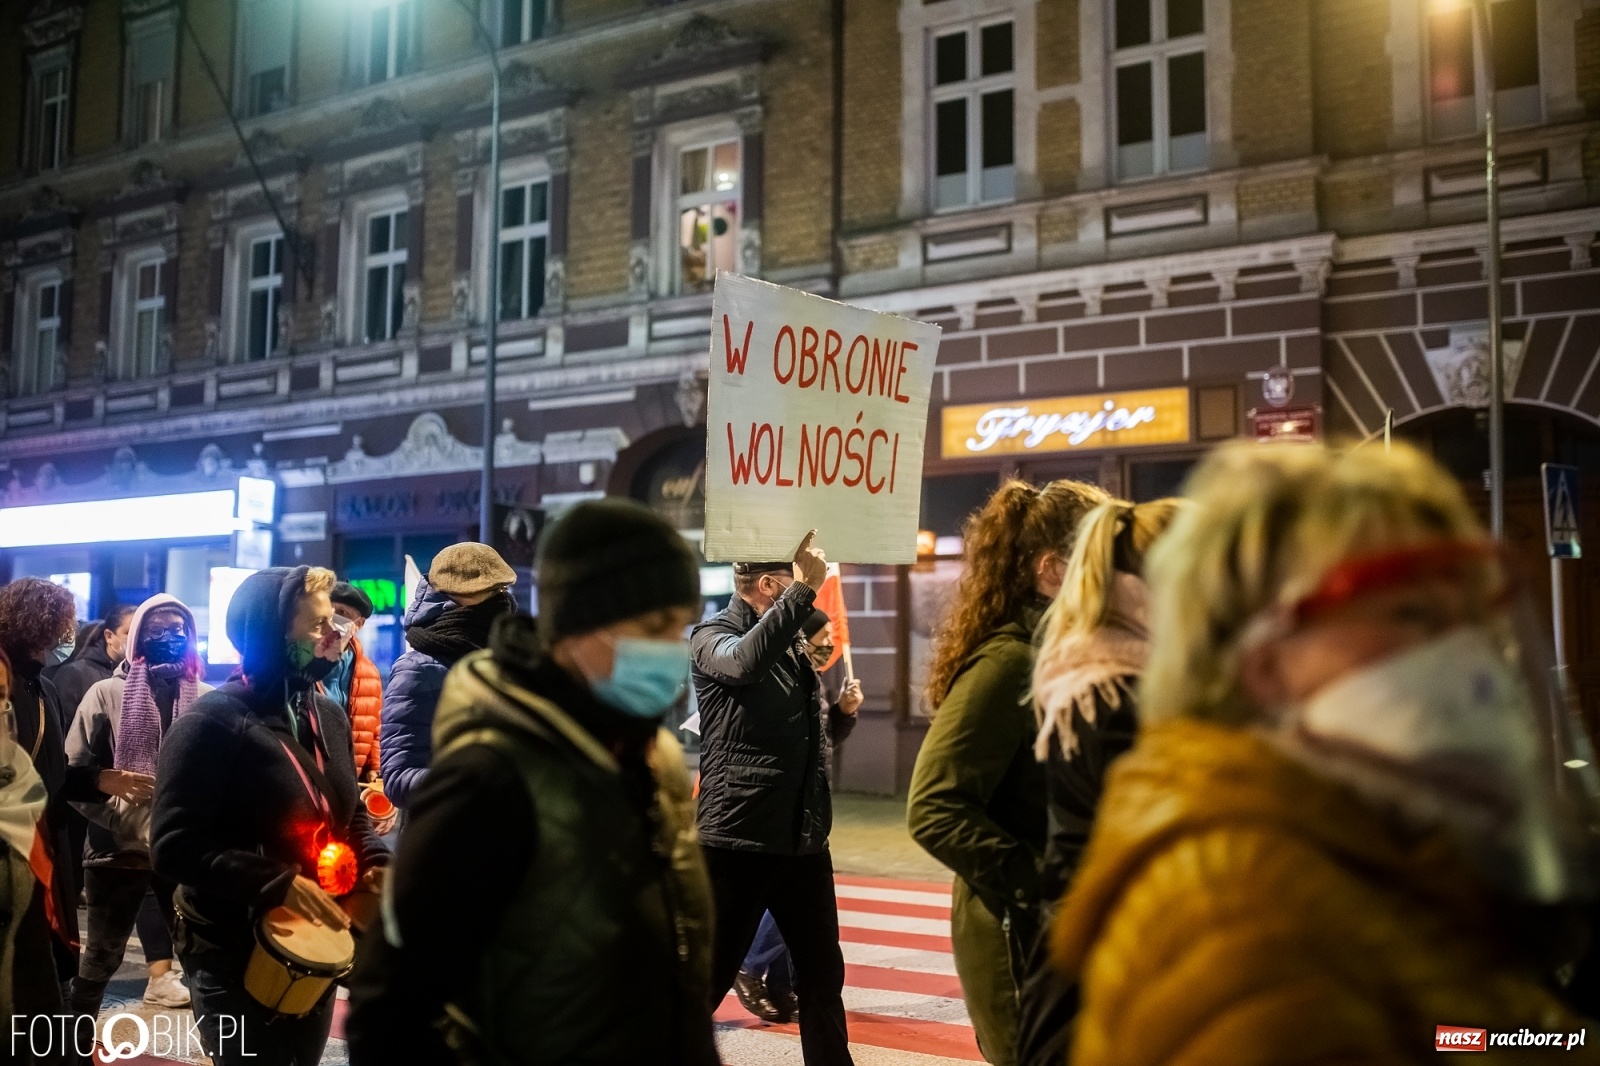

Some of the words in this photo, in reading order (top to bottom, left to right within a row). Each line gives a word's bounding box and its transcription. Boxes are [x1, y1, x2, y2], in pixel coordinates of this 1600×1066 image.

[723, 313, 754, 376] W
[773, 324, 919, 404] OBRONIE
[726, 410, 900, 495] WOLNOŚCI
[965, 399, 1156, 452] Fryzjer
